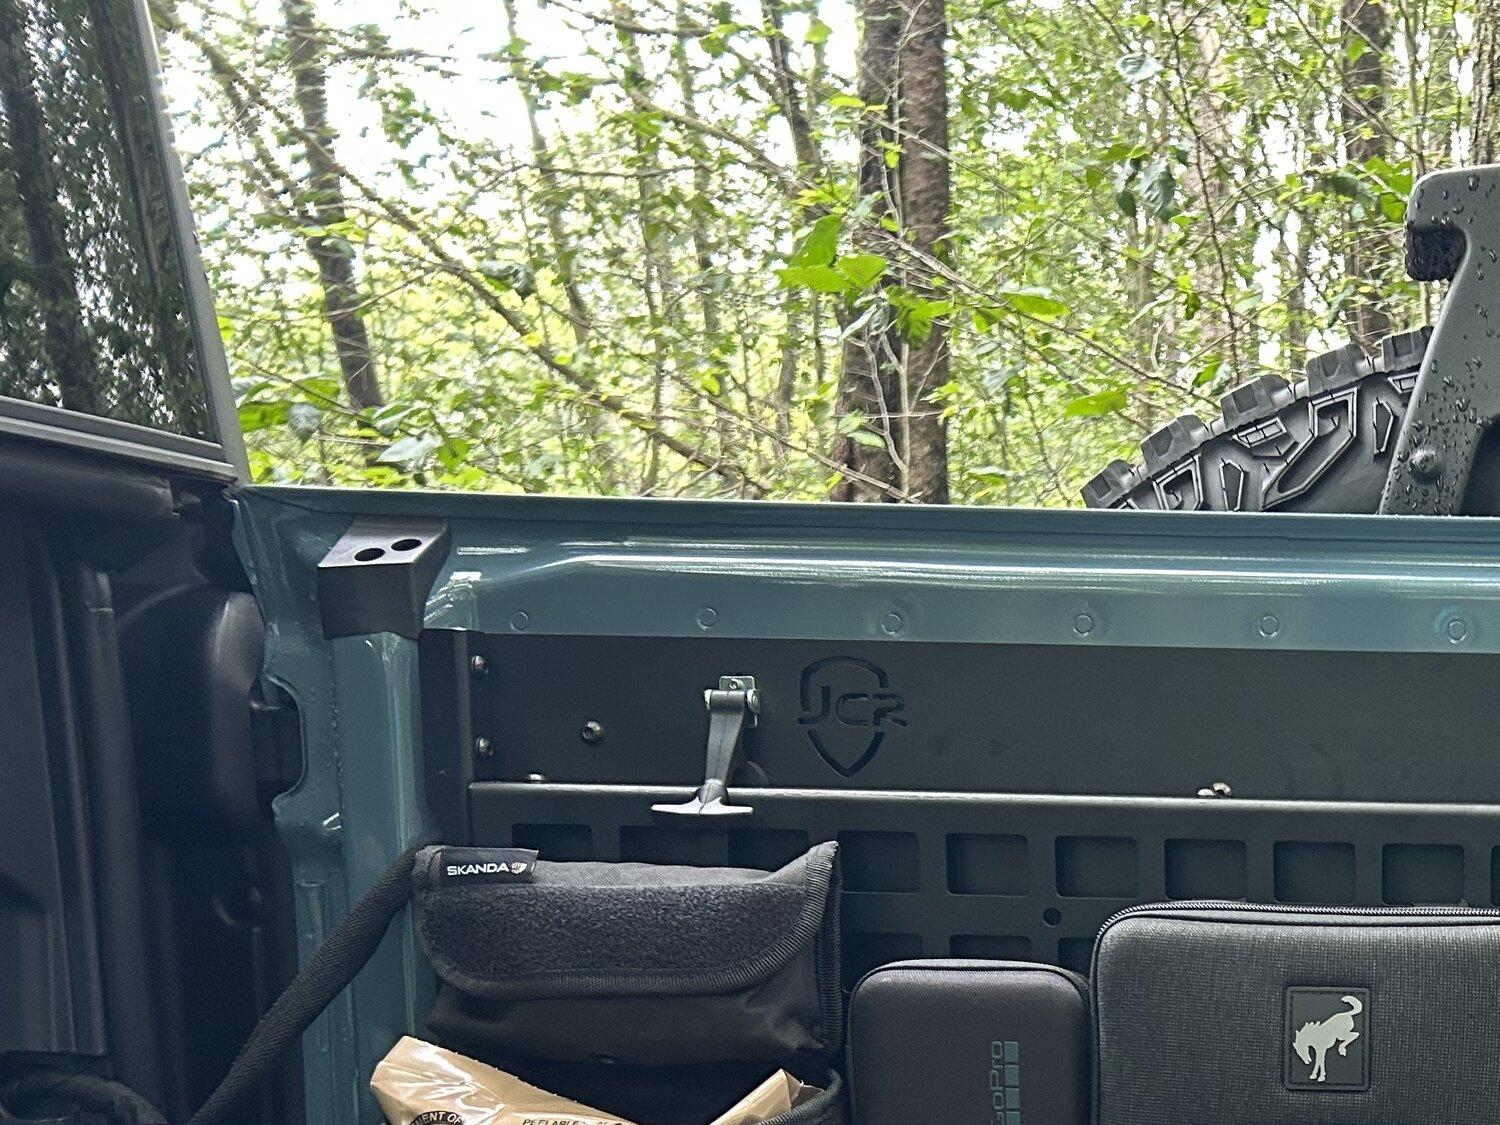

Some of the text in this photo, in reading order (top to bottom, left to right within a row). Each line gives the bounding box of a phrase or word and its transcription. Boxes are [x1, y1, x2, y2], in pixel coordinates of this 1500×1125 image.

[797, 685, 908, 727] JCR
[446, 862, 510, 876] SKANDA
[446, 1113, 463, 1125] OF
